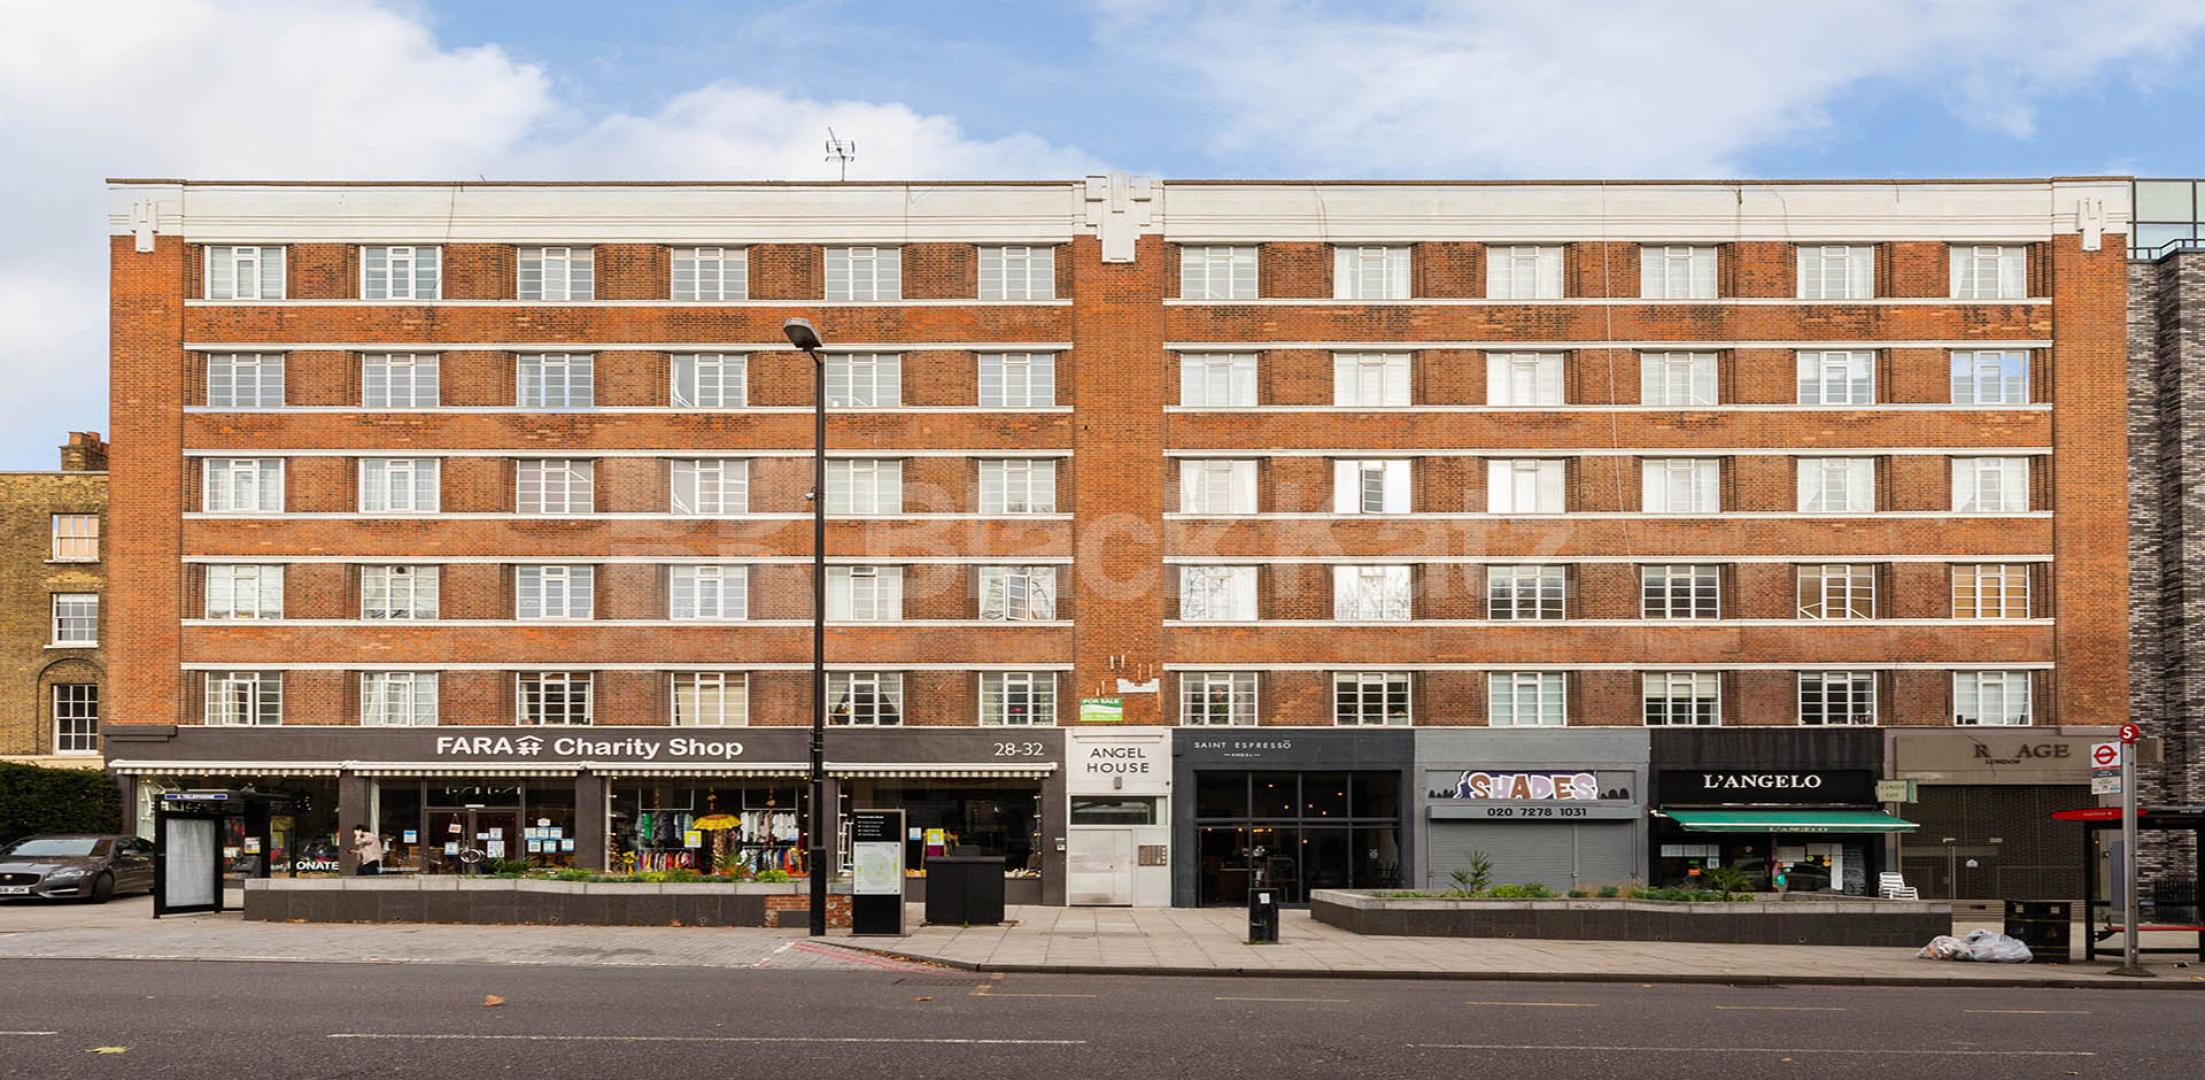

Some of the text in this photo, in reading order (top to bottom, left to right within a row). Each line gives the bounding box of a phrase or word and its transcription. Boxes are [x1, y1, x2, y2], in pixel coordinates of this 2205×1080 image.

[2122, 725, 2133, 739] S
[436, 737, 744, 760] FARA Charity Shop
[992, 742, 1045, 757] 28-32
[1193, 741, 1227, 749] SAINT
[1089, 747, 1147, 759] ANGEL
[1086, 762, 1150, 774] HOUSE
[1468, 771, 1598, 800] SHADES
[1703, 774, 1823, 789] L'ANGELO
[1486, 807, 1587, 817] 020 7278 1031
[295, 861, 341, 871] ONATE
